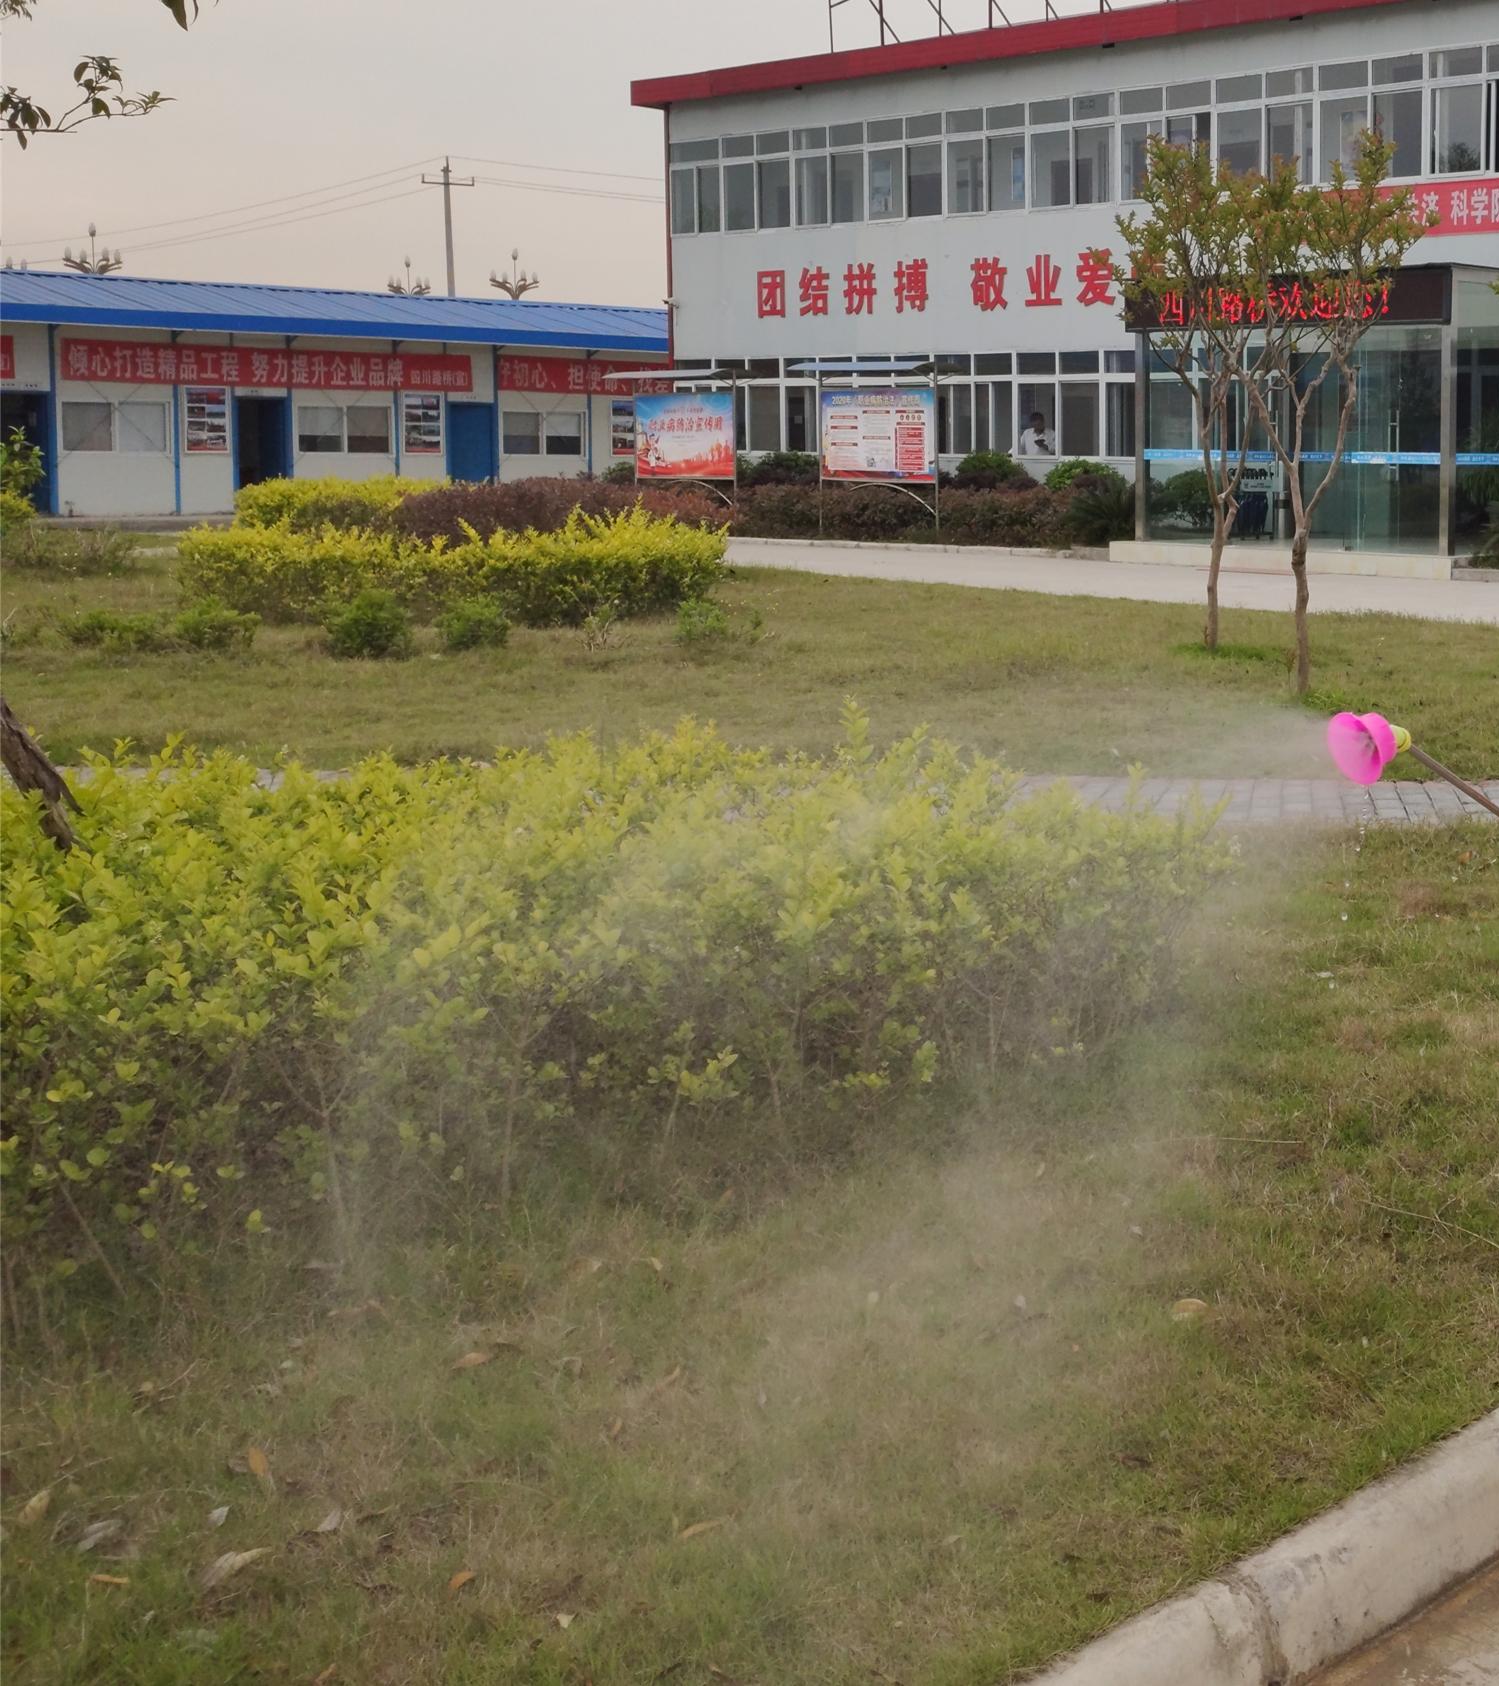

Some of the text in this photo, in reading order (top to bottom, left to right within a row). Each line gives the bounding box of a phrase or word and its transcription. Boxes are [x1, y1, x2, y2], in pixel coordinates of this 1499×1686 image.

[756, 247, 1165, 318] 团结拼搏 敬业爱
[68, 344, 240, 382] 倾心打造精品工程
[252, 352, 404, 386] 努力提升企业品牌
